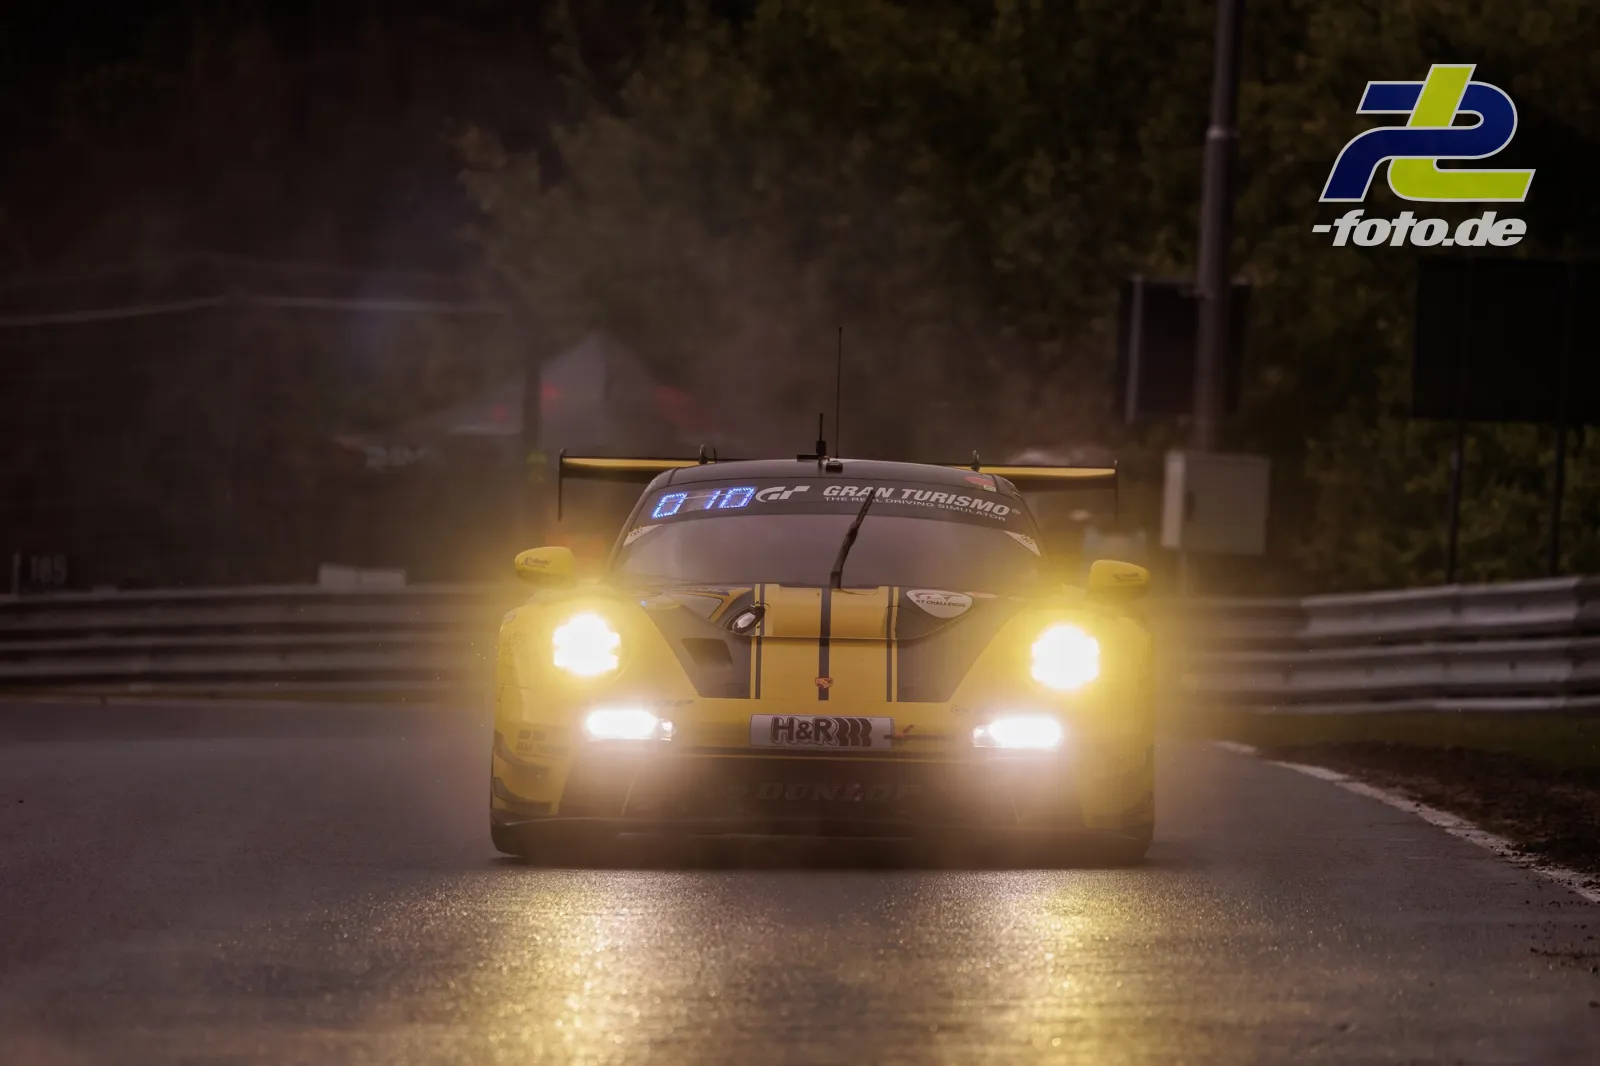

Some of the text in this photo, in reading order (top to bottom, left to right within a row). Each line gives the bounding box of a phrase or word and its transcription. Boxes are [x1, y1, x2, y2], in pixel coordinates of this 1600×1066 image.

[822, 485, 896, 499] GRAN
[885, 498, 936, 508] DRIVING
[937, 503, 1007, 522] SIMULATOR
[772, 716, 840, 746] H&R
